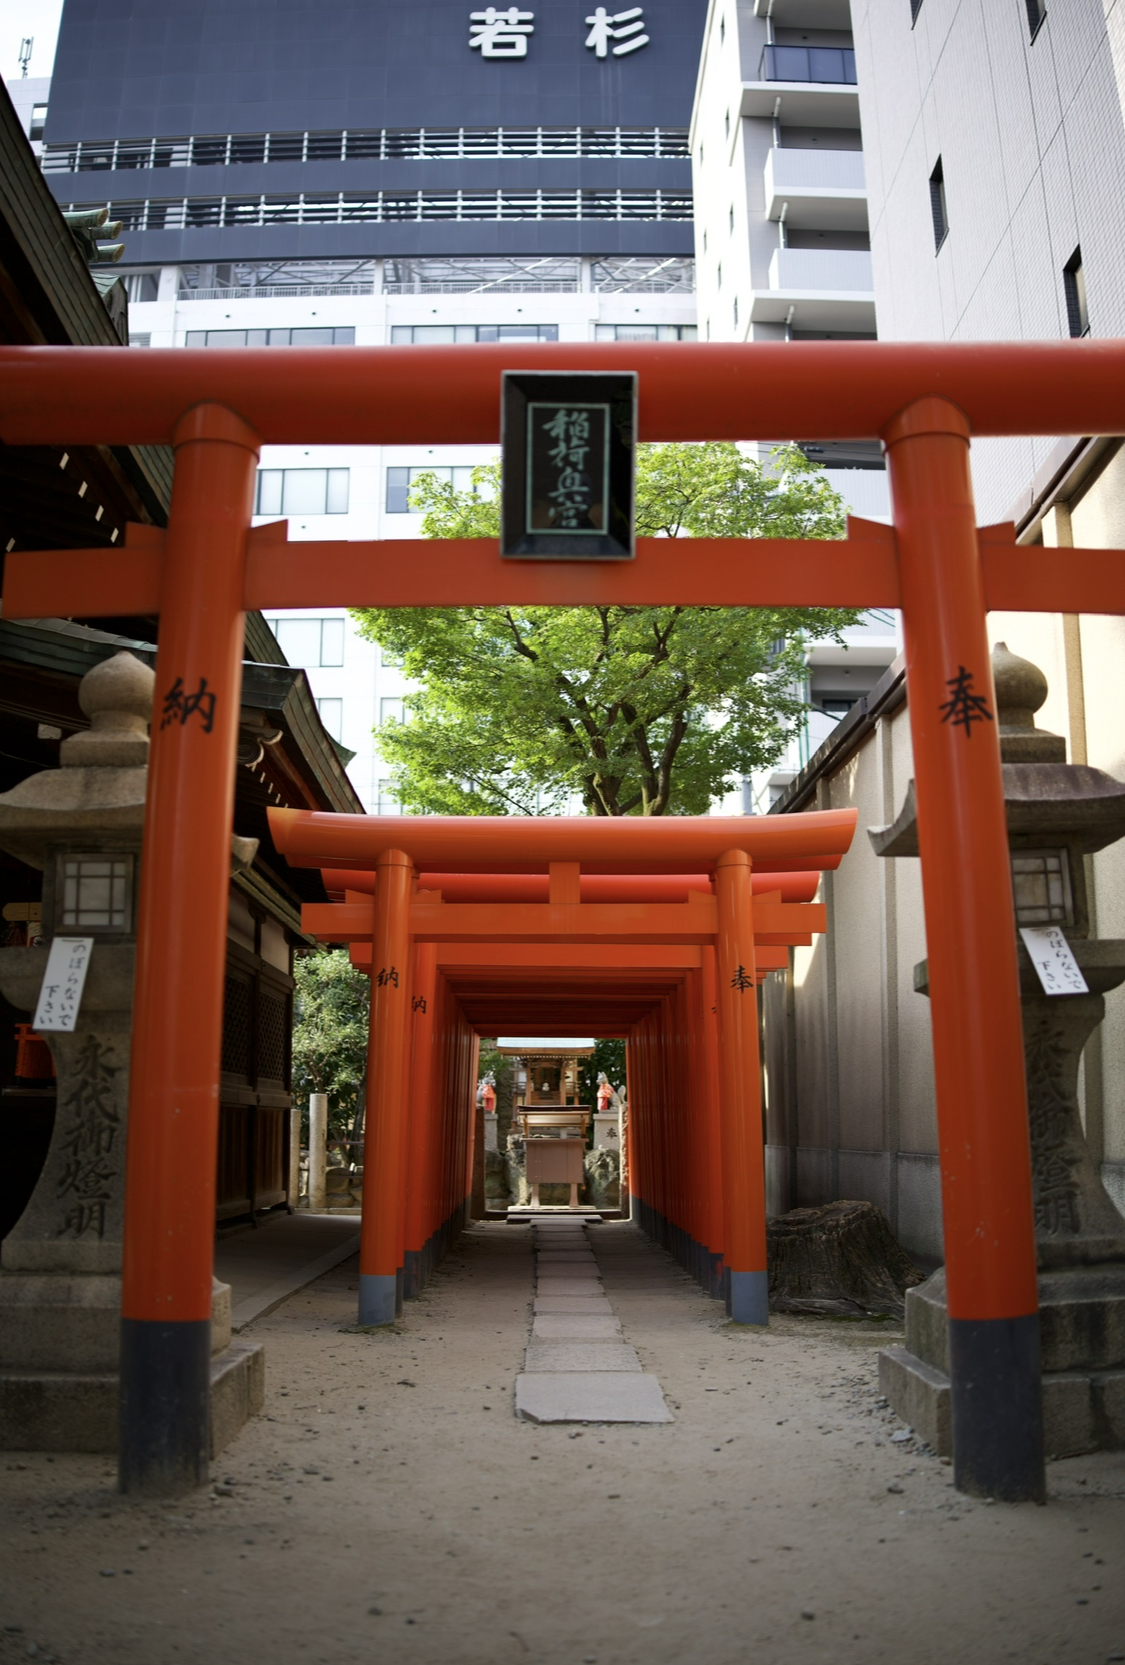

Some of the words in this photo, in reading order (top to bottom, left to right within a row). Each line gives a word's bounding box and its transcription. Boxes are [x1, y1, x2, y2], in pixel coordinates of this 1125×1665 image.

[469, 6, 650, 58] 若杉
[160, 677, 216, 734] 納
[939, 665, 994, 739] 奉
[376, 966, 399, 989] 納
[730, 964, 754, 994] 奉
[1037, 960, 1061, 990] 下さい
[39, 985, 60, 1025] 下さい
